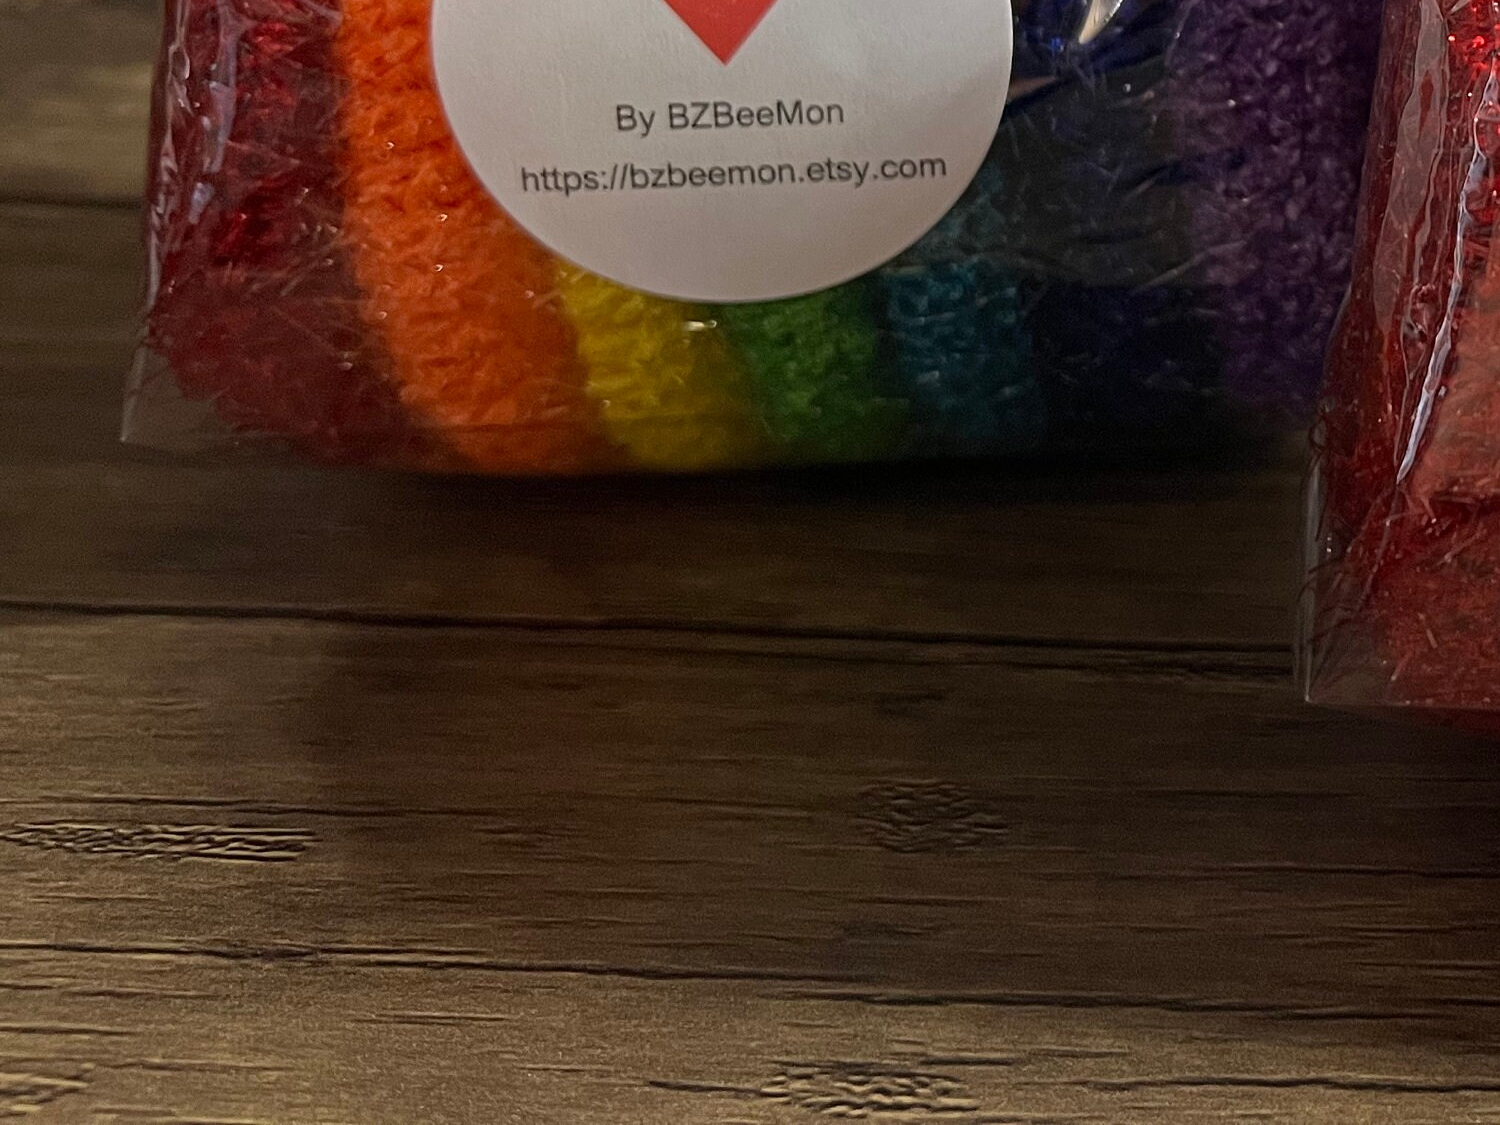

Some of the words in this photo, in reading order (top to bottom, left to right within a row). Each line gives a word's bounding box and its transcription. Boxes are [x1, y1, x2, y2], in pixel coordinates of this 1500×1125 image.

[615, 104, 656, 139] By
[667, 100, 844, 130] BZBeeMon
[520, 158, 947, 198] https://bzbeemon.etsy.com
